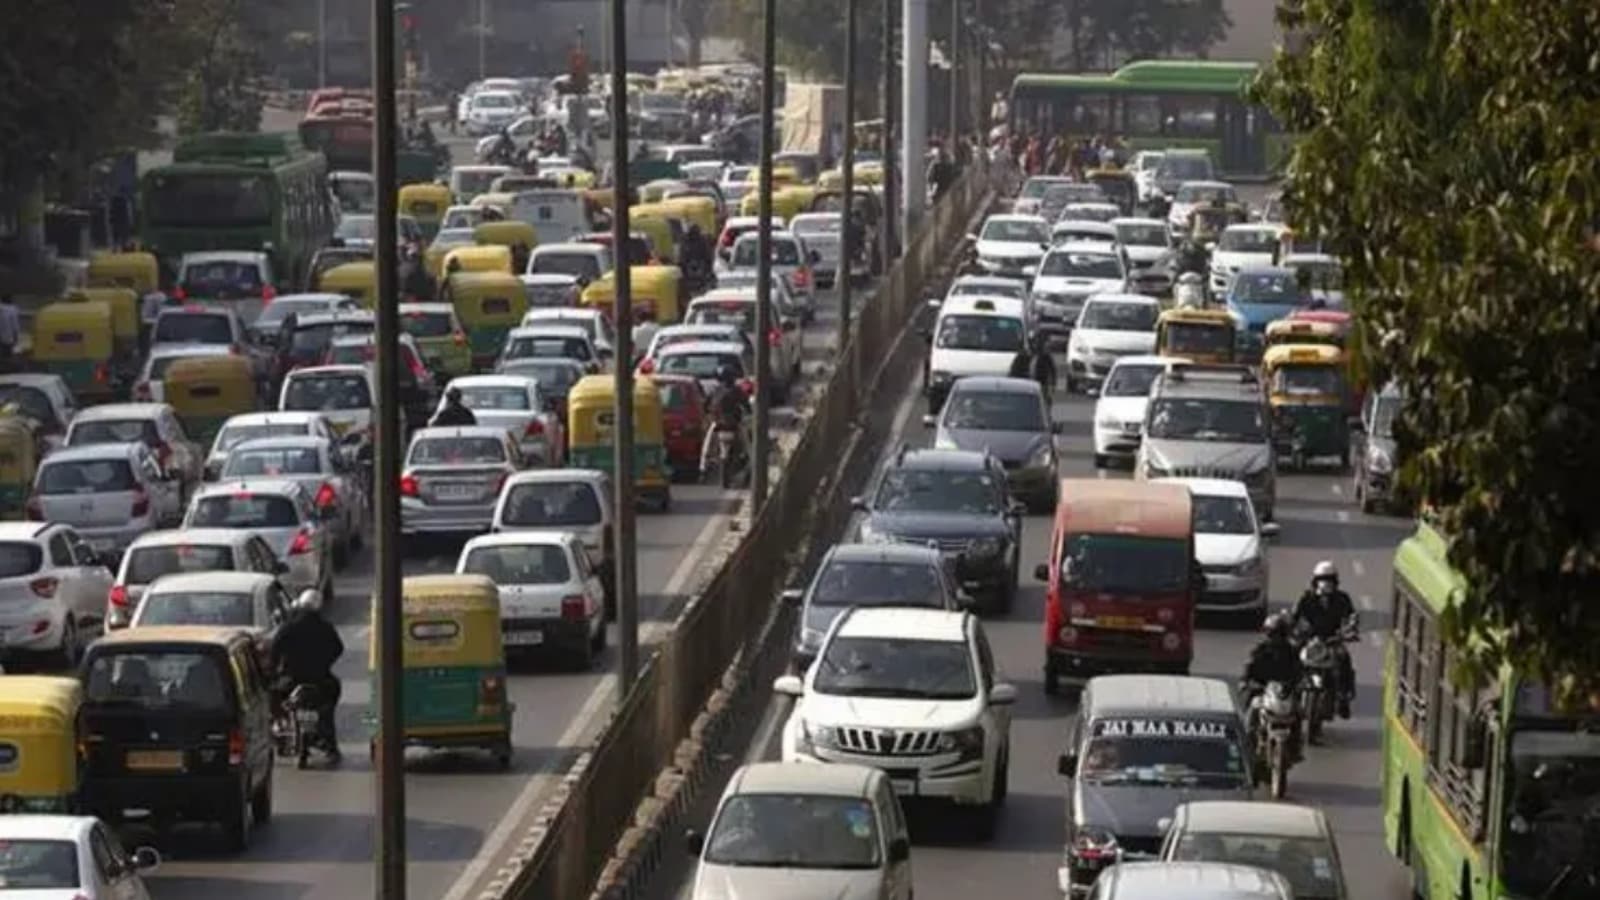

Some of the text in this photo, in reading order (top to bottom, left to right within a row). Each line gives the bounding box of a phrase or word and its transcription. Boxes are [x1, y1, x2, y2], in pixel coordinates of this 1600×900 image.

[1102, 720, 1227, 738] JAI MAA KAALI
